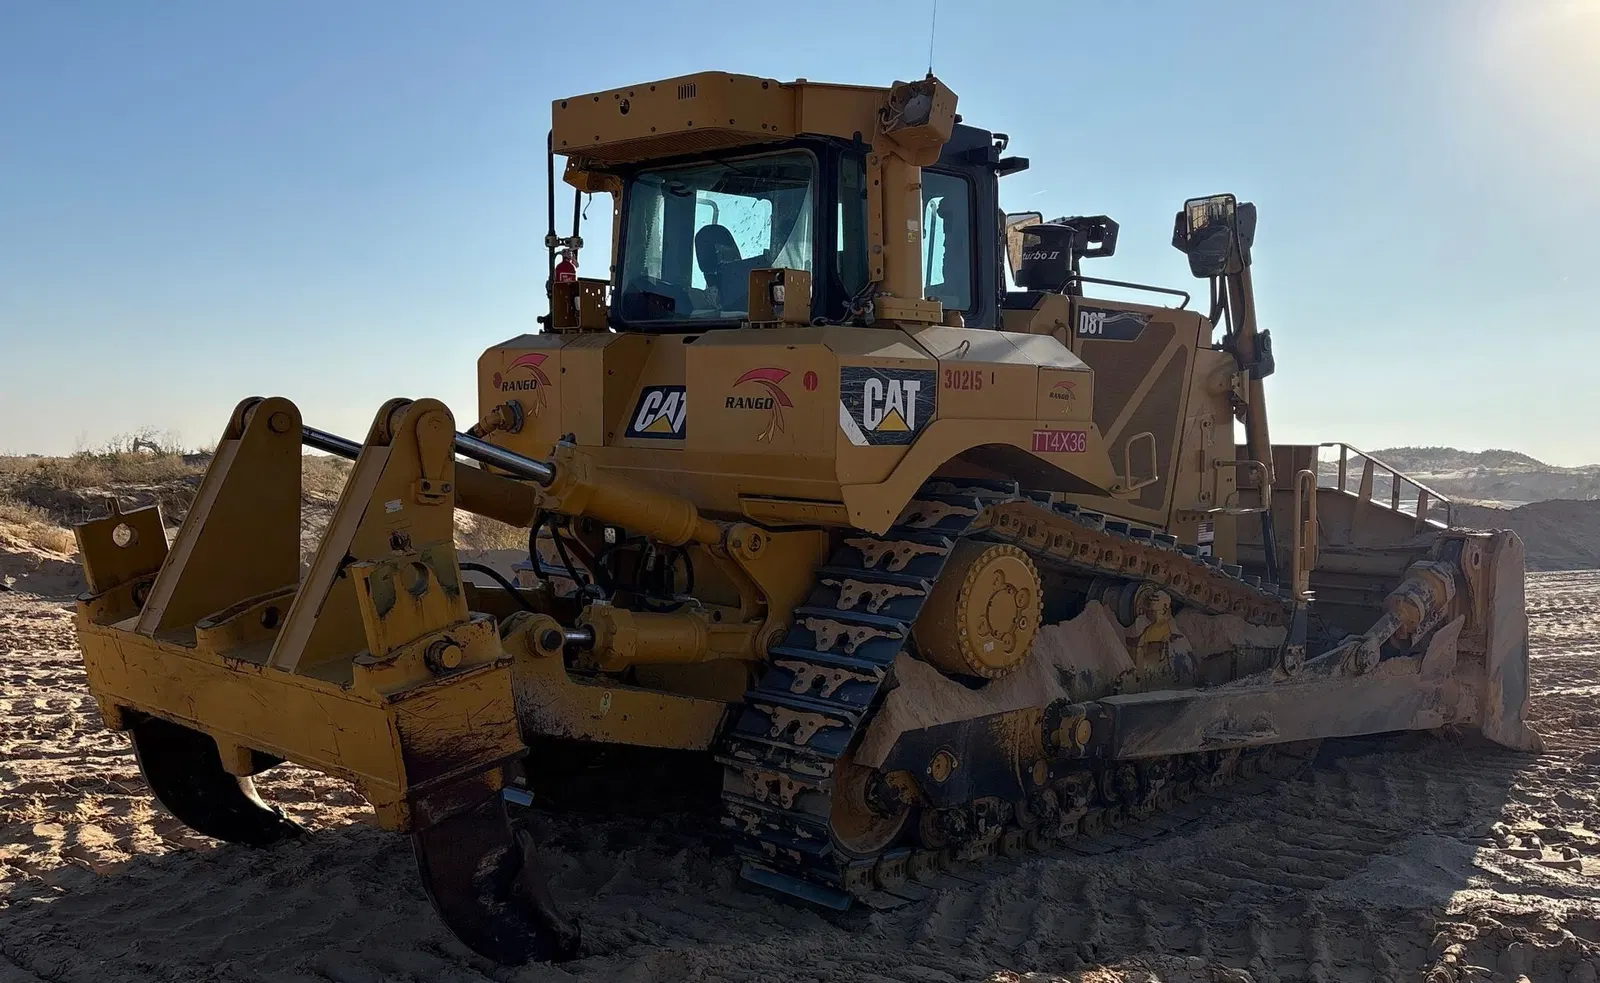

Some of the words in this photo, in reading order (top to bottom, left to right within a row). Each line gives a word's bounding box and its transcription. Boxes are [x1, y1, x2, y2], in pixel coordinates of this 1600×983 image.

[1048, 251, 1060, 260] II
[1080, 311, 1107, 335] D8T
[501, 379, 537, 392] RANGO
[944, 369, 983, 390] 30215
[725, 397, 774, 410] RANGO
[1049, 391, 1070, 400] RANGO
[863, 378, 921, 431] CAT
[1033, 431, 1086, 452] TT4X36
